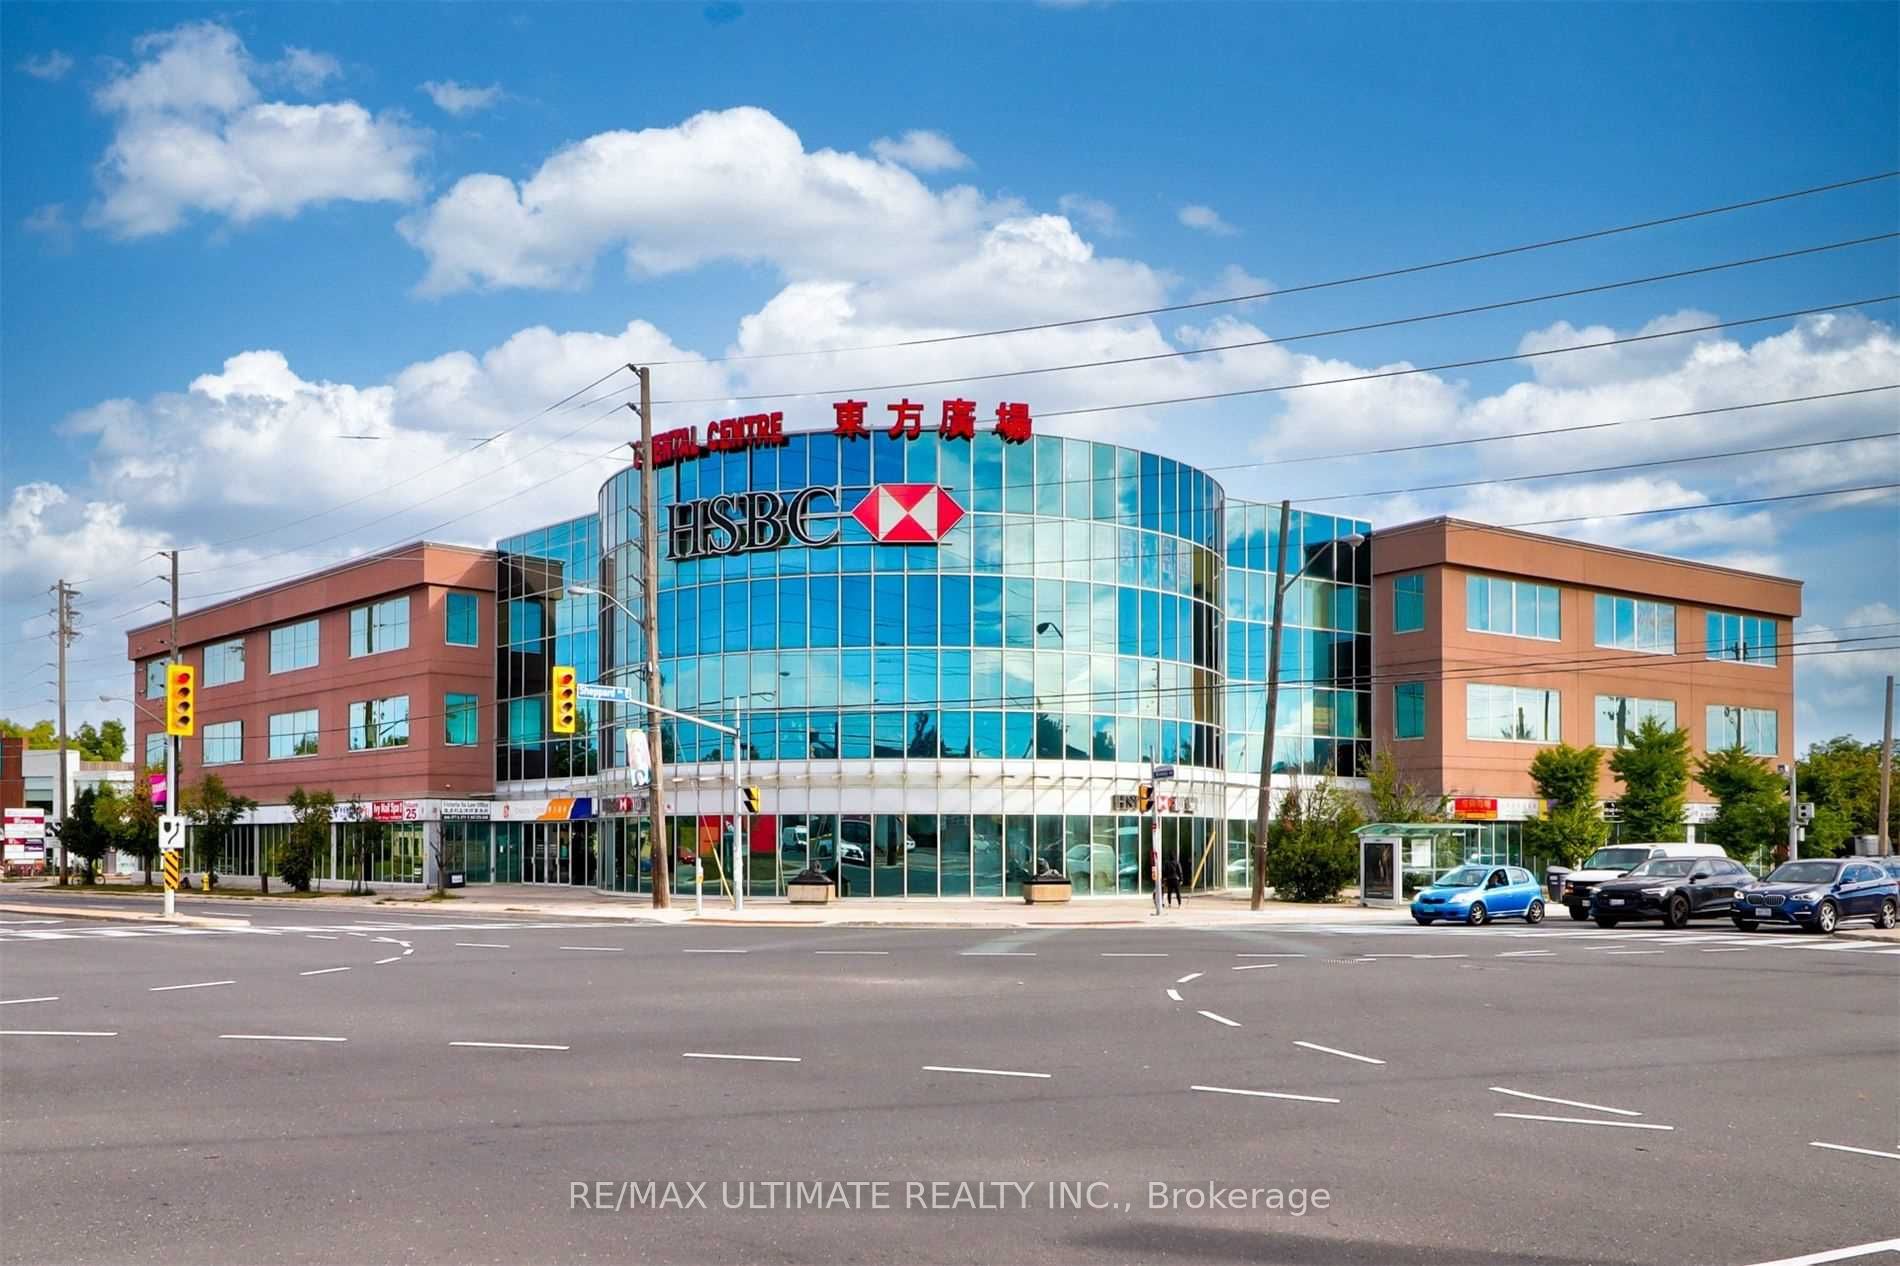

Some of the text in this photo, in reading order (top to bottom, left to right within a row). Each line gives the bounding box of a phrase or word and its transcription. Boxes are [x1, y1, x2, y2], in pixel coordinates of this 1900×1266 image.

[707, 411, 784, 452] CENTRE
[832, 399, 1033, 443] 東方廣場
[665, 484, 841, 561] HSBC
[406, 808, 417, 820] 25
